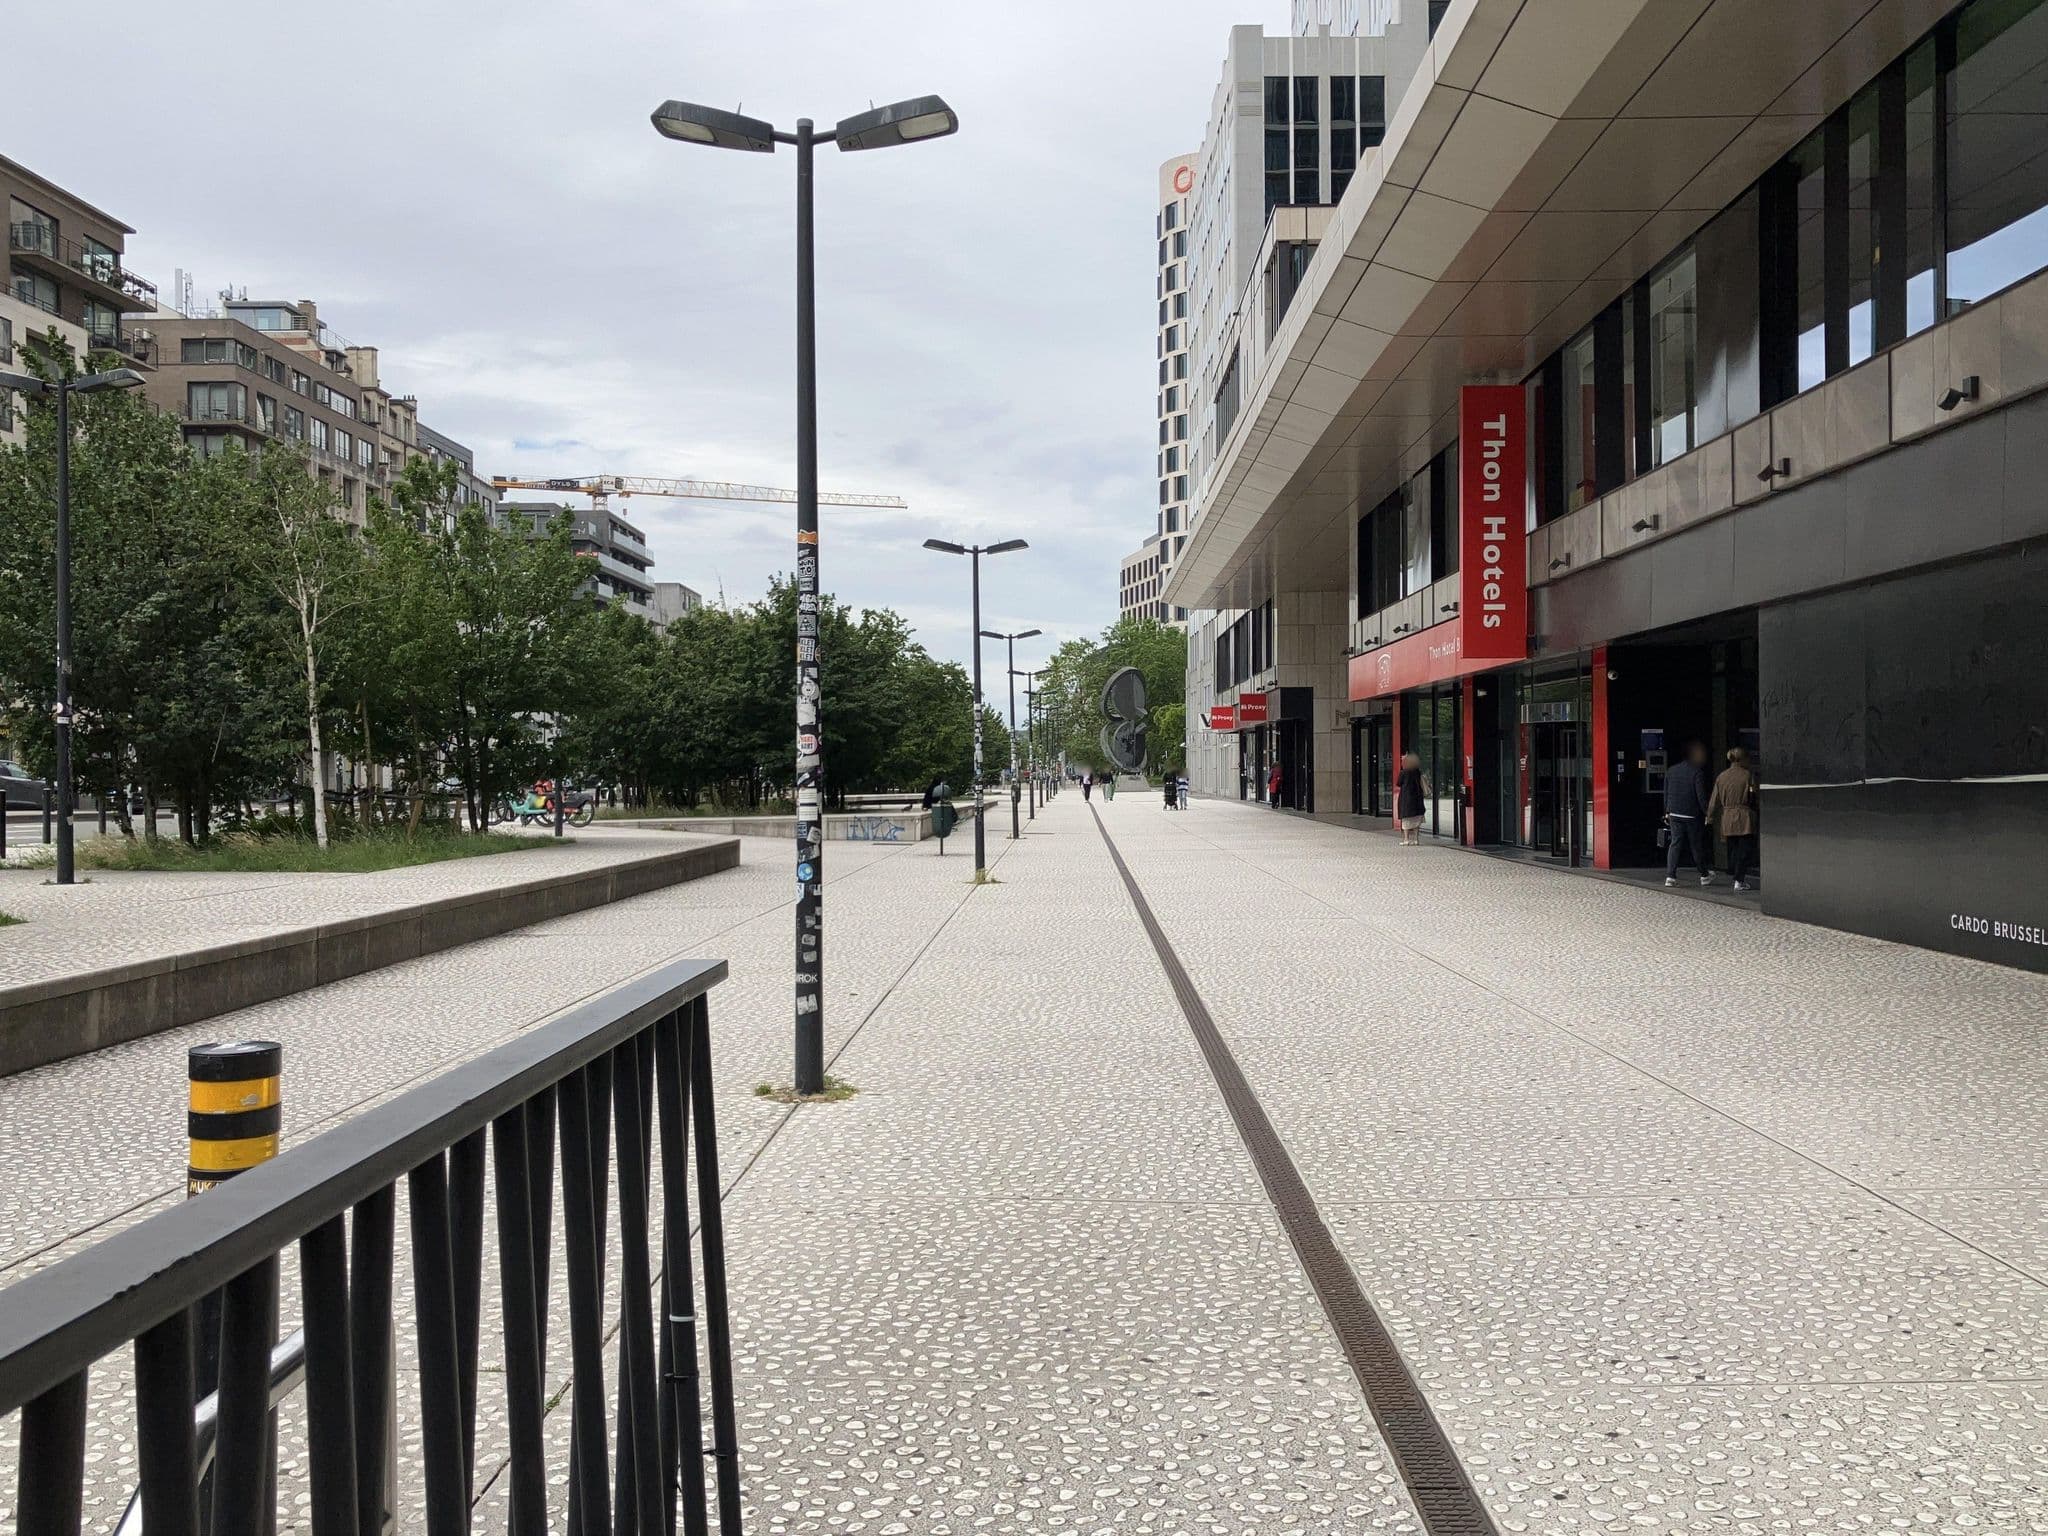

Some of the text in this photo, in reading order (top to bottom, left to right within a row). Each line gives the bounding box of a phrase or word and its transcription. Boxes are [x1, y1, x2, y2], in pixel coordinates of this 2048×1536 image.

[1483, 413, 1506, 629] Thon Hotels
[1951, 914, 1989, 934] CARDO
